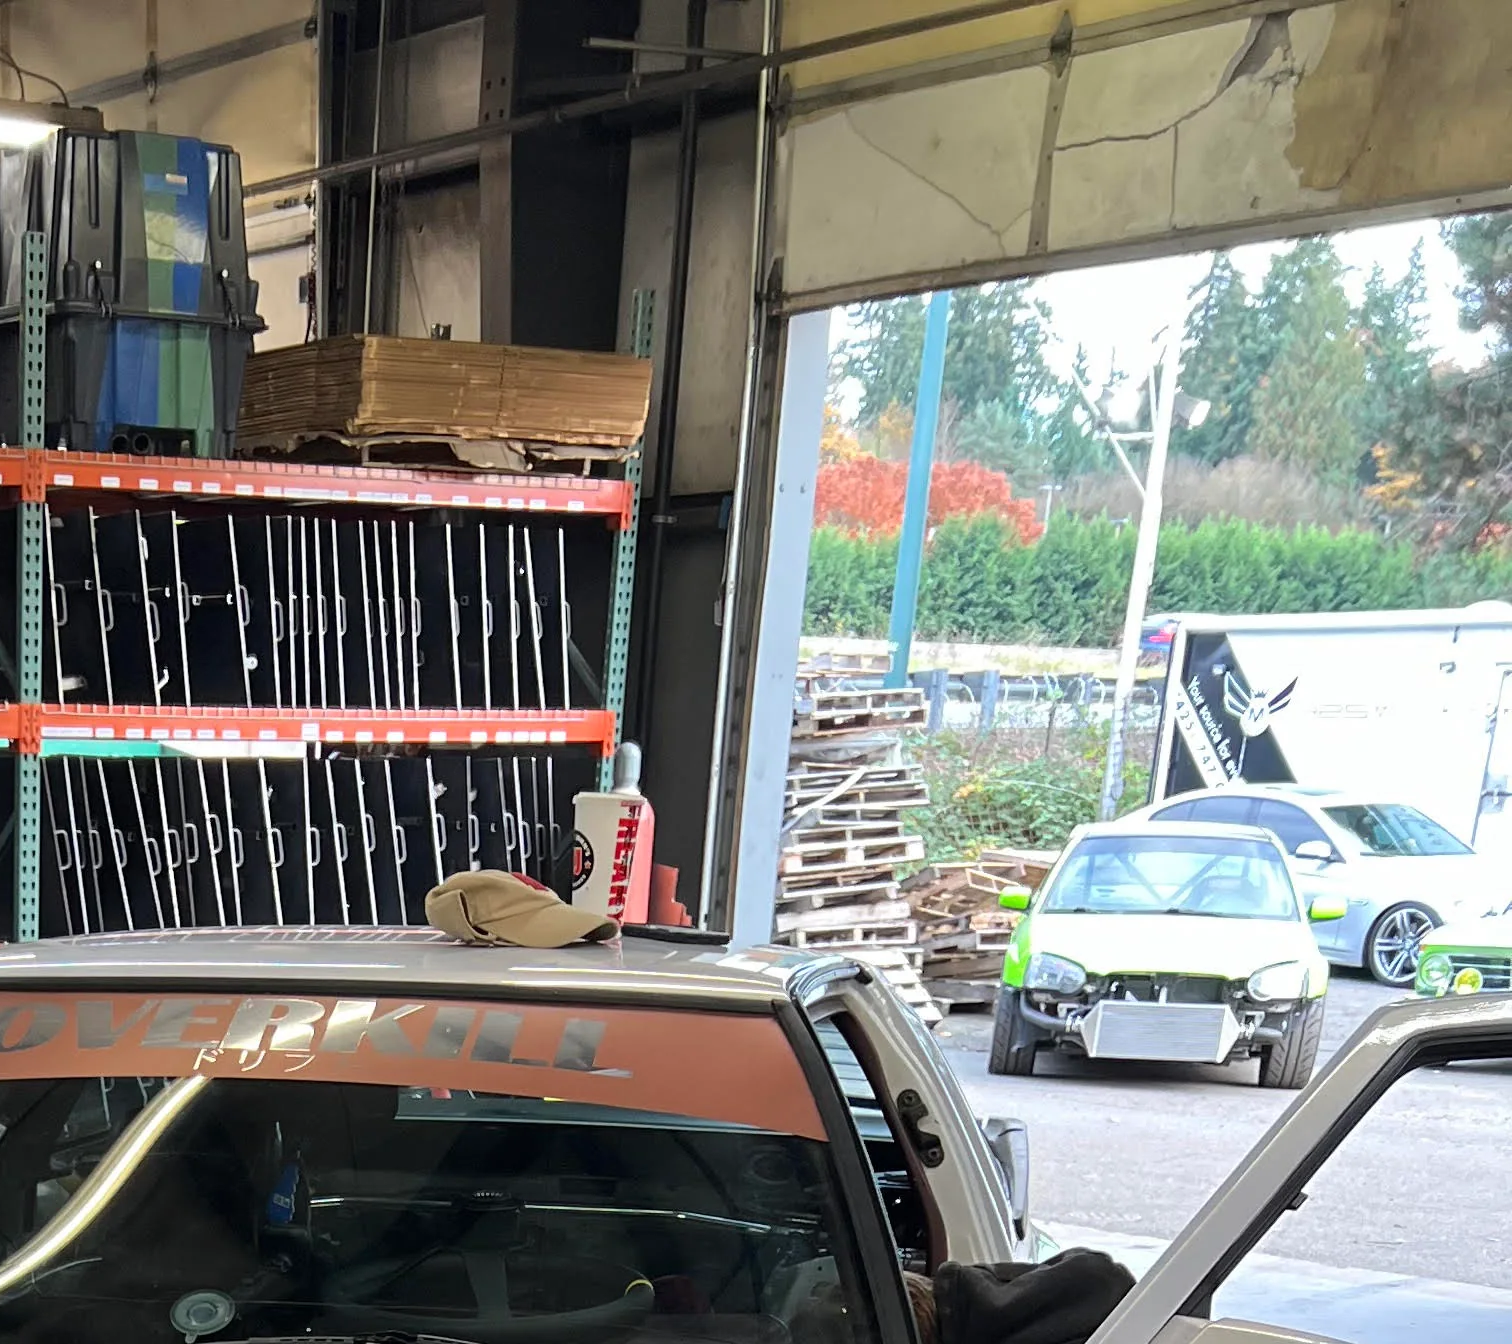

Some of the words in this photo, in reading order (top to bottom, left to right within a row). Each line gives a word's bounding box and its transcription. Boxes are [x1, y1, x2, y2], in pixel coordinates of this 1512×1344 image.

[1188, 674, 1205, 707] Your
[1199, 703, 1223, 745] source
[1216, 736, 1231, 760] for
